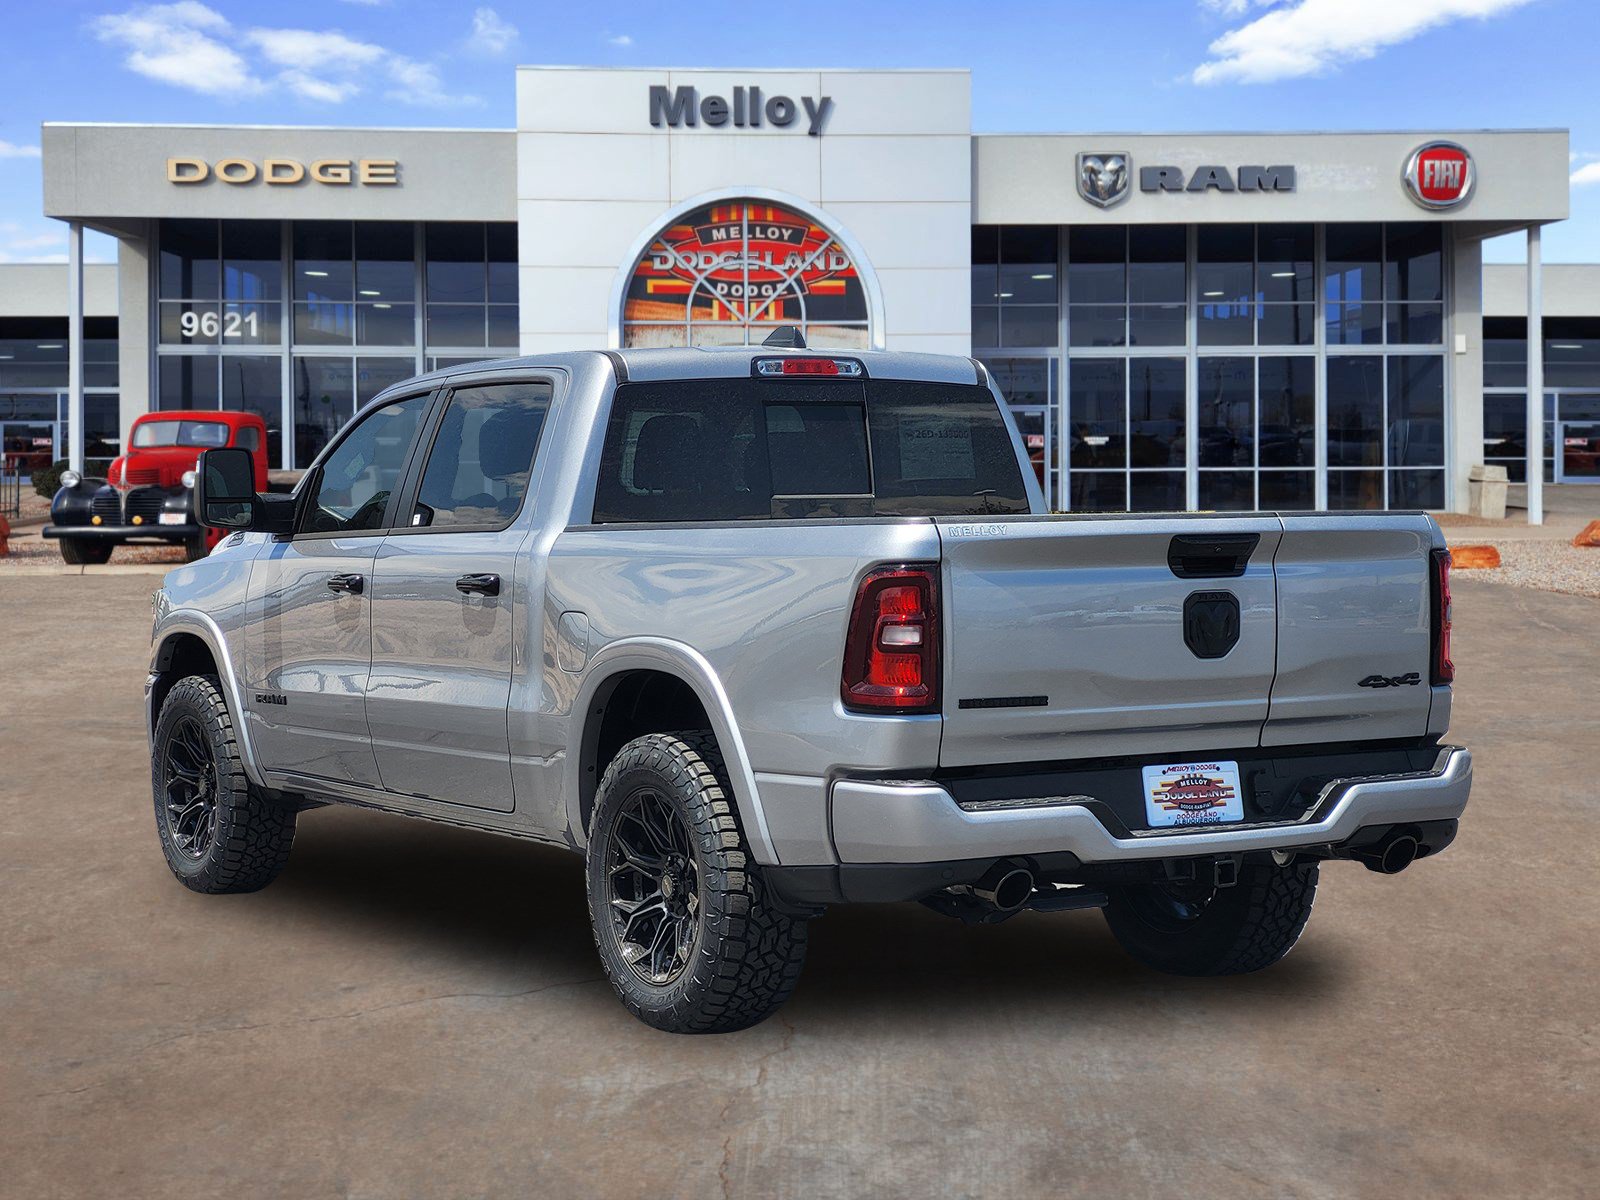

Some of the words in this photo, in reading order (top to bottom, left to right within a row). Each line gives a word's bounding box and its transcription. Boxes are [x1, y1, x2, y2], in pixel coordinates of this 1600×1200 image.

[649, 85, 832, 136] Melloy
[167, 158, 398, 185] DODGE
[1140, 165, 1297, 193] RAM
[1423, 159, 1464, 189] FIAT
[716, 283, 788, 297] DODGE
[181, 311, 259, 338] 9621
[948, 524, 1008, 538] MELLOY
[1195, 763, 1217, 771] DODGE
[1180, 779, 1208, 787] MELLOY
[1176, 811, 1218, 820] DODGELAND
